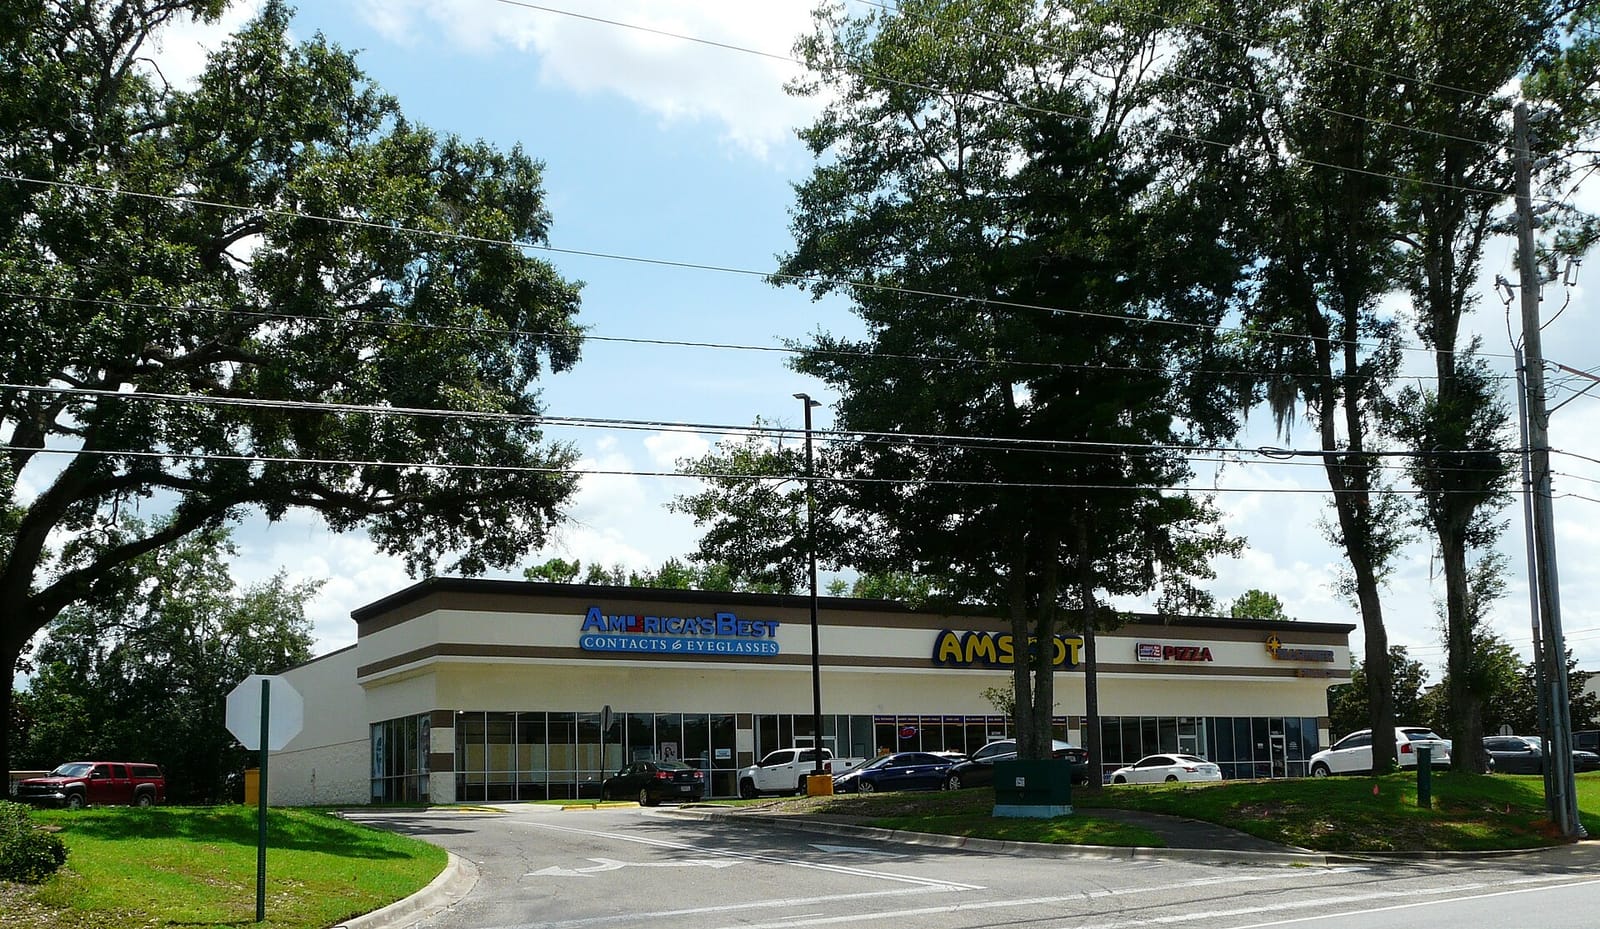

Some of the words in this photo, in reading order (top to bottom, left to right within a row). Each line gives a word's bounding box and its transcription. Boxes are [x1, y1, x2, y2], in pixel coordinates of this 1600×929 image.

[715, 612, 780, 638] BEST
[584, 637, 667, 650] CONTACTS
[671, 639, 682, 650] &
[687, 641, 777, 653] EYEGLASSES
[1162, 646, 1214, 662] PIZZA
